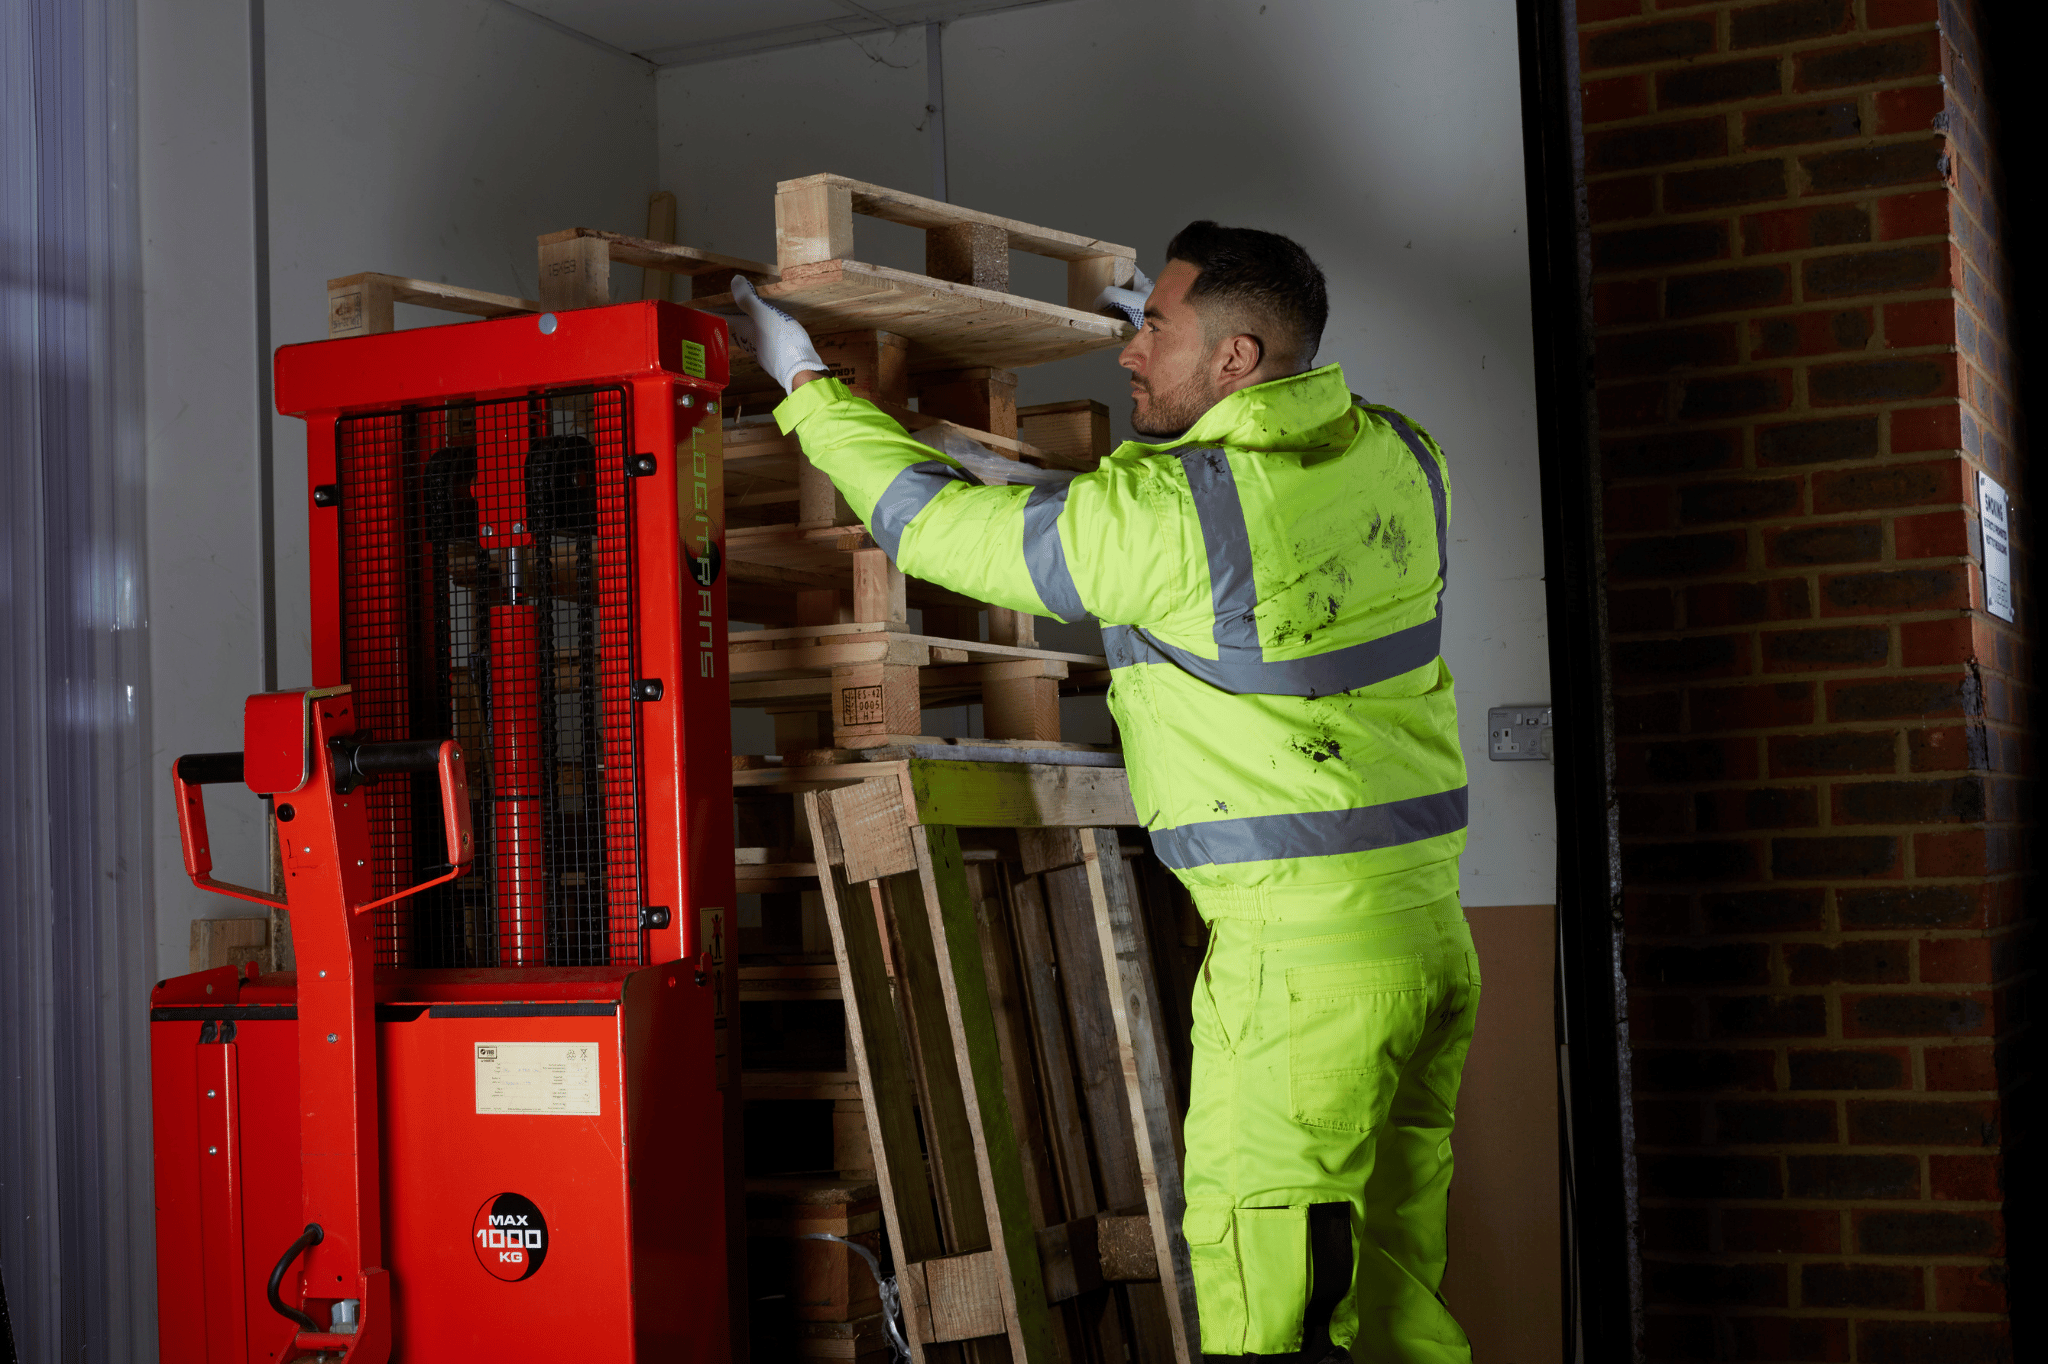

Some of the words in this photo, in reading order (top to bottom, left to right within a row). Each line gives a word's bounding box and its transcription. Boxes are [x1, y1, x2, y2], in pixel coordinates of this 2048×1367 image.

[692, 426, 714, 678] LOGITRANS
[858, 689, 880, 699] ES-42
[860, 700, 880, 710] 0005
[863, 711, 875, 721] HT
[488, 1214, 529, 1226] MAX
[476, 1229, 542, 1248] 1000
[499, 1251, 523, 1263] KG
